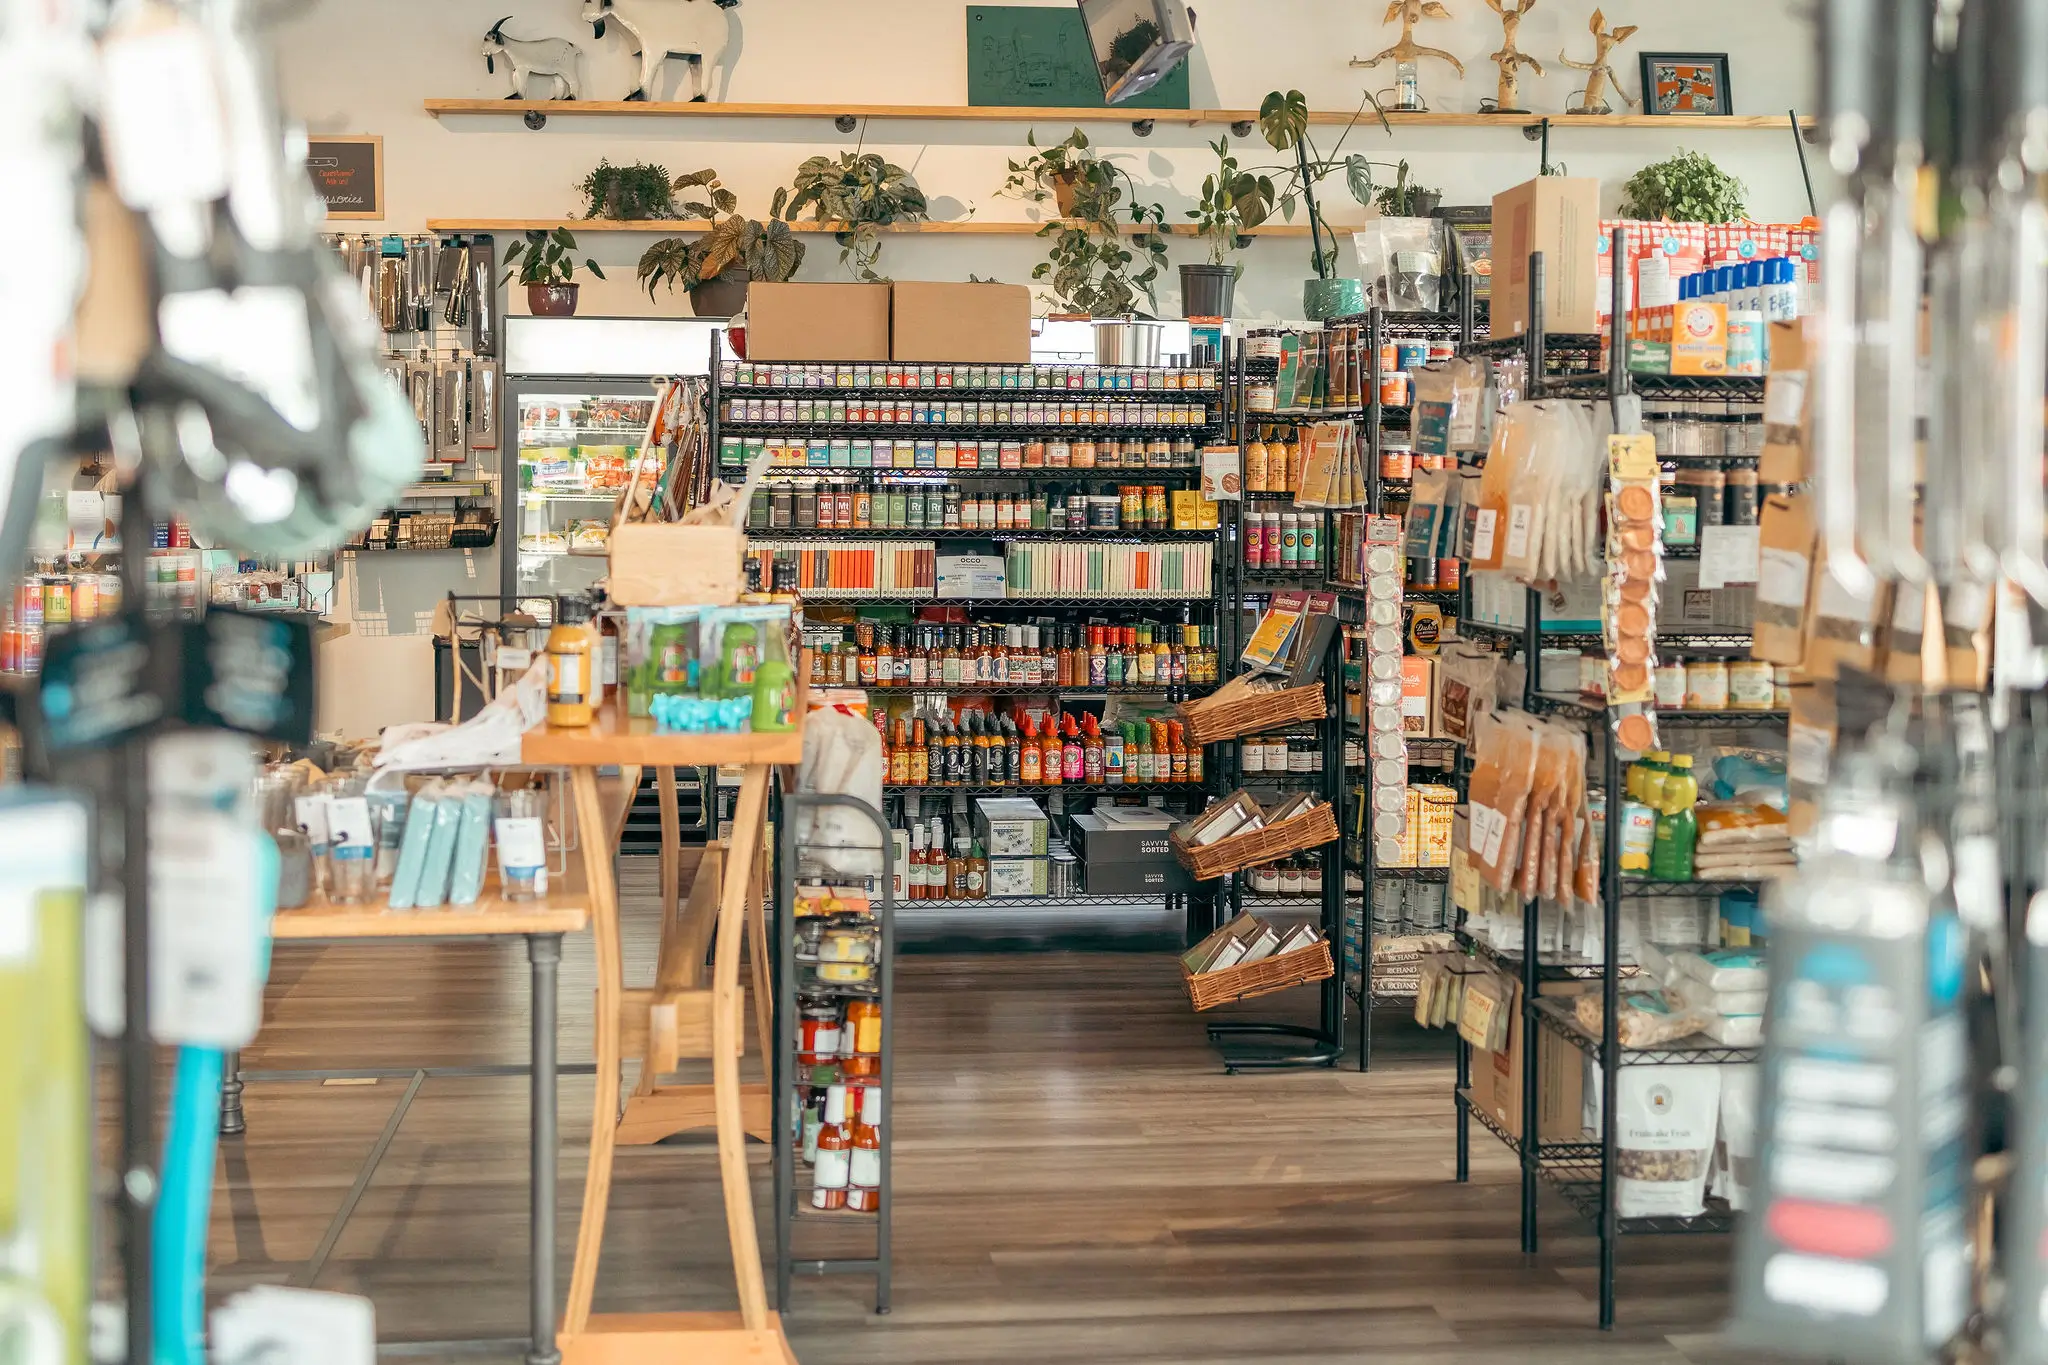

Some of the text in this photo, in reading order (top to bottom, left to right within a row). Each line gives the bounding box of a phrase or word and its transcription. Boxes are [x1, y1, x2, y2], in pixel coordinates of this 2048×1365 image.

[820, 501, 831, 510] Mt
[838, 501, 849, 510] Mt
[873, 501, 883, 510] Gr
[893, 502, 904, 511] Gr
[945, 504, 957, 514] Vk
[1423, 804, 1455, 812] BROTH
[1388, 953, 1420, 961] RICELAND
[1386, 966, 1418, 974] RICELAND
[1387, 981, 1418, 990] RICELAND
